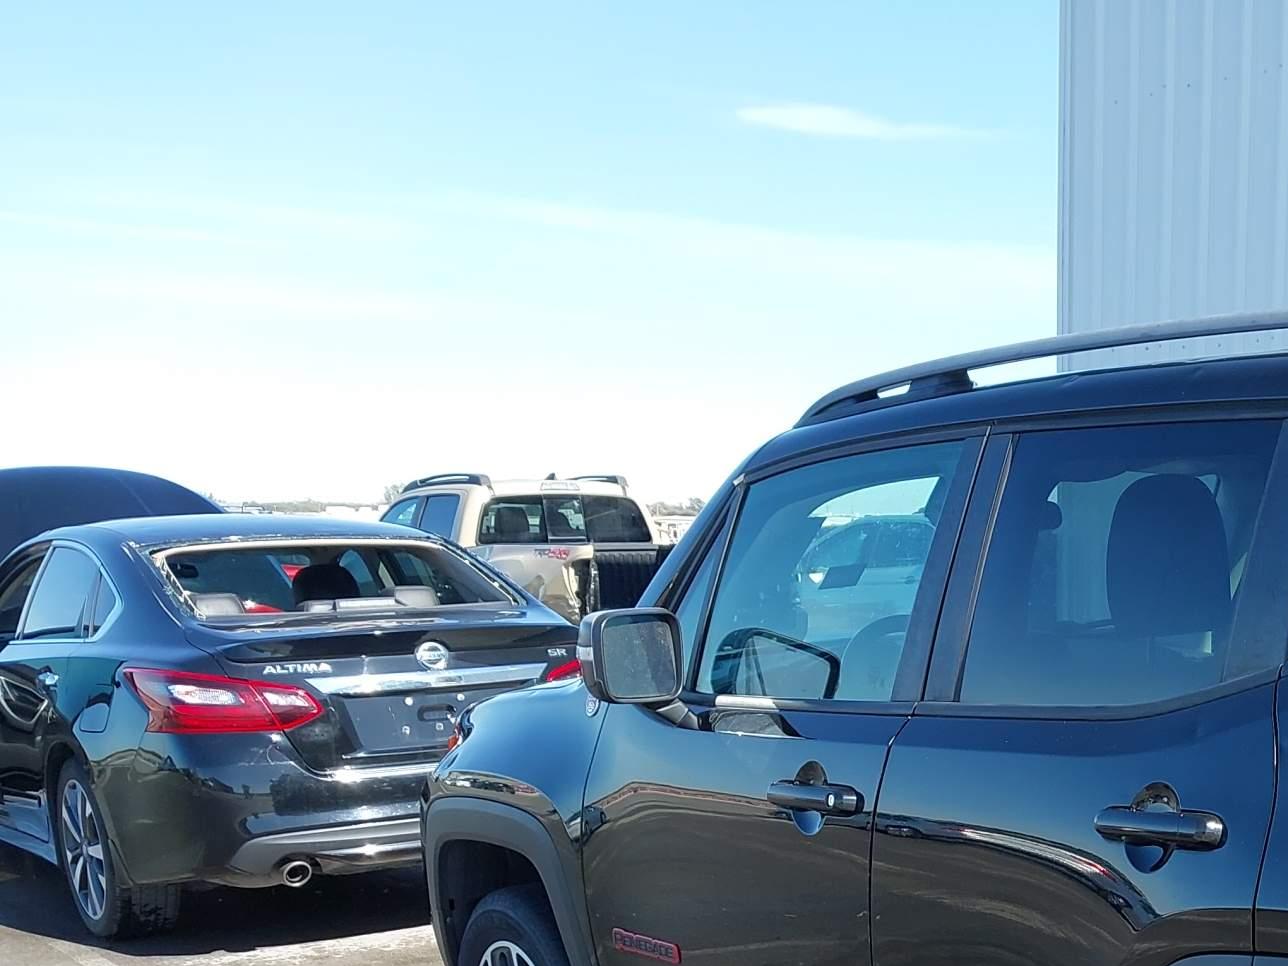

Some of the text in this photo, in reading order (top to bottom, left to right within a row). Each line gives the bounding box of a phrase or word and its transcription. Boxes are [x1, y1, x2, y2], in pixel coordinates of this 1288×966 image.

[546, 647, 568, 657] SR
[262, 662, 333, 675] ALTIMA
[613, 929, 675, 958] RENEGADE
